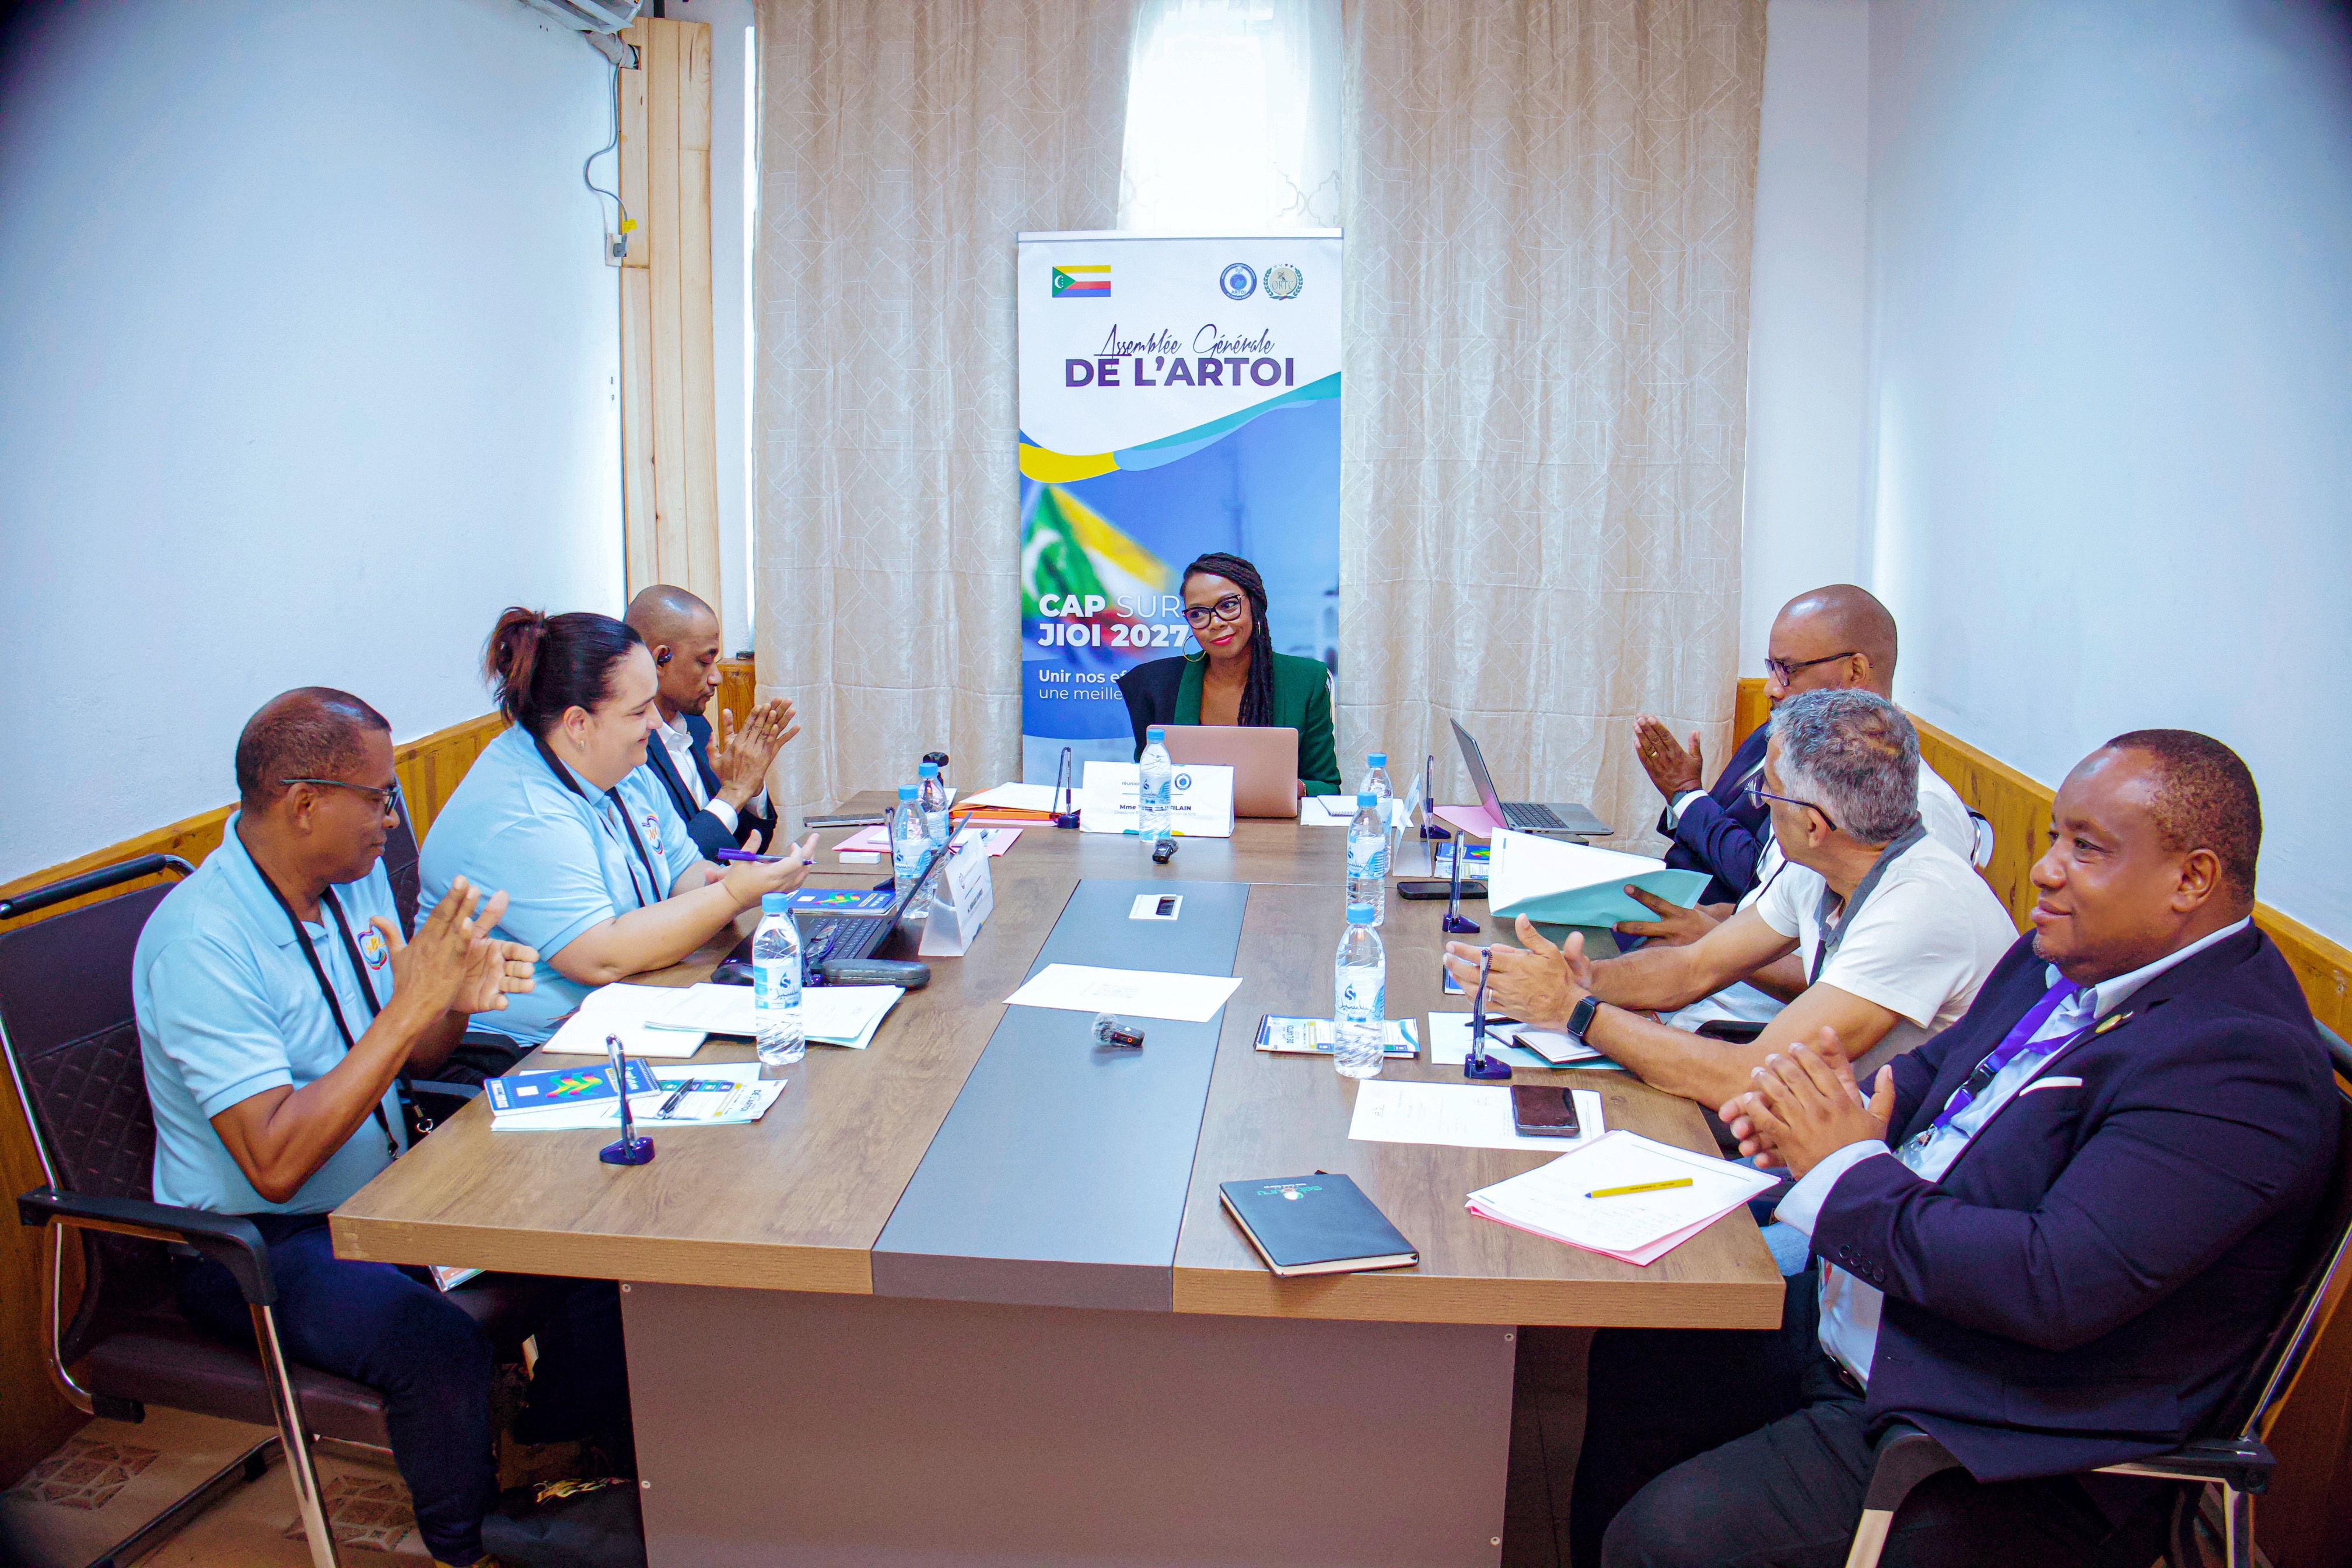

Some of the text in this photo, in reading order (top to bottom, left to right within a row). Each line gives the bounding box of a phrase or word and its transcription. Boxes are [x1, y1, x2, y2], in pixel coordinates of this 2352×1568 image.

[1272, 280, 1294, 290] ORTC
[1094, 323, 1275, 366] Assemblée Générale
[1066, 356, 1294, 387] DE L'ARTOI
[1039, 594, 1181, 618] CAP SUR
[1038, 624, 1189, 648] JIOI 2027
[1039, 669, 1127, 683] Unir nos ef
[1039, 687, 1124, 700] une meille
